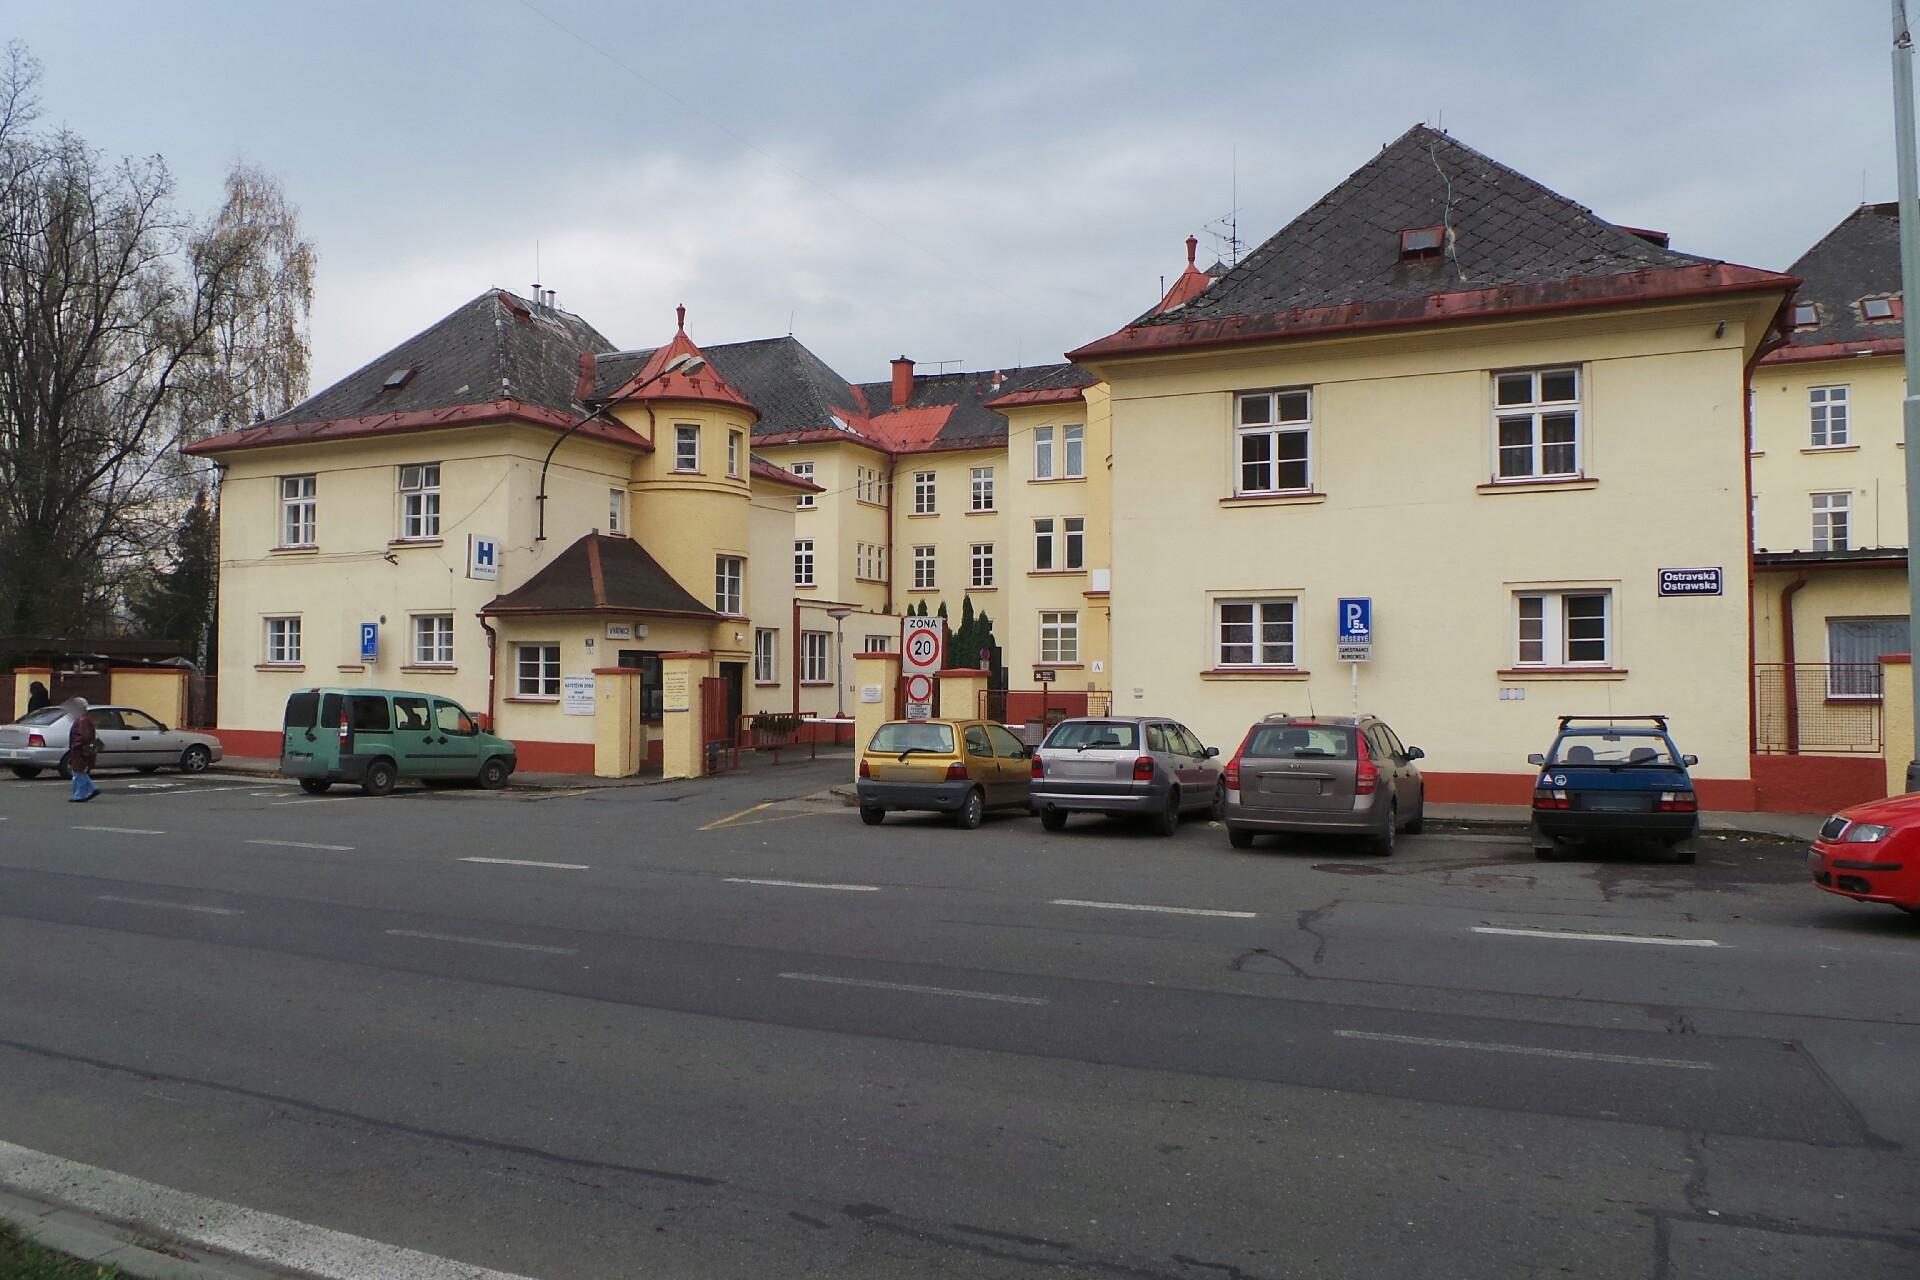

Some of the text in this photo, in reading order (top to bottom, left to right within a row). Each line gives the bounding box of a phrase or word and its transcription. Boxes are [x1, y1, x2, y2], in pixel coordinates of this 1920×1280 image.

[478, 541, 494, 566] H
[1664, 571, 1716, 581] Ostravská
[1663, 581, 1717, 591] Ostrawska
[1347, 603, 1362, 629] P
[364, 627, 374, 646] P
[914, 640, 931, 656] 20
